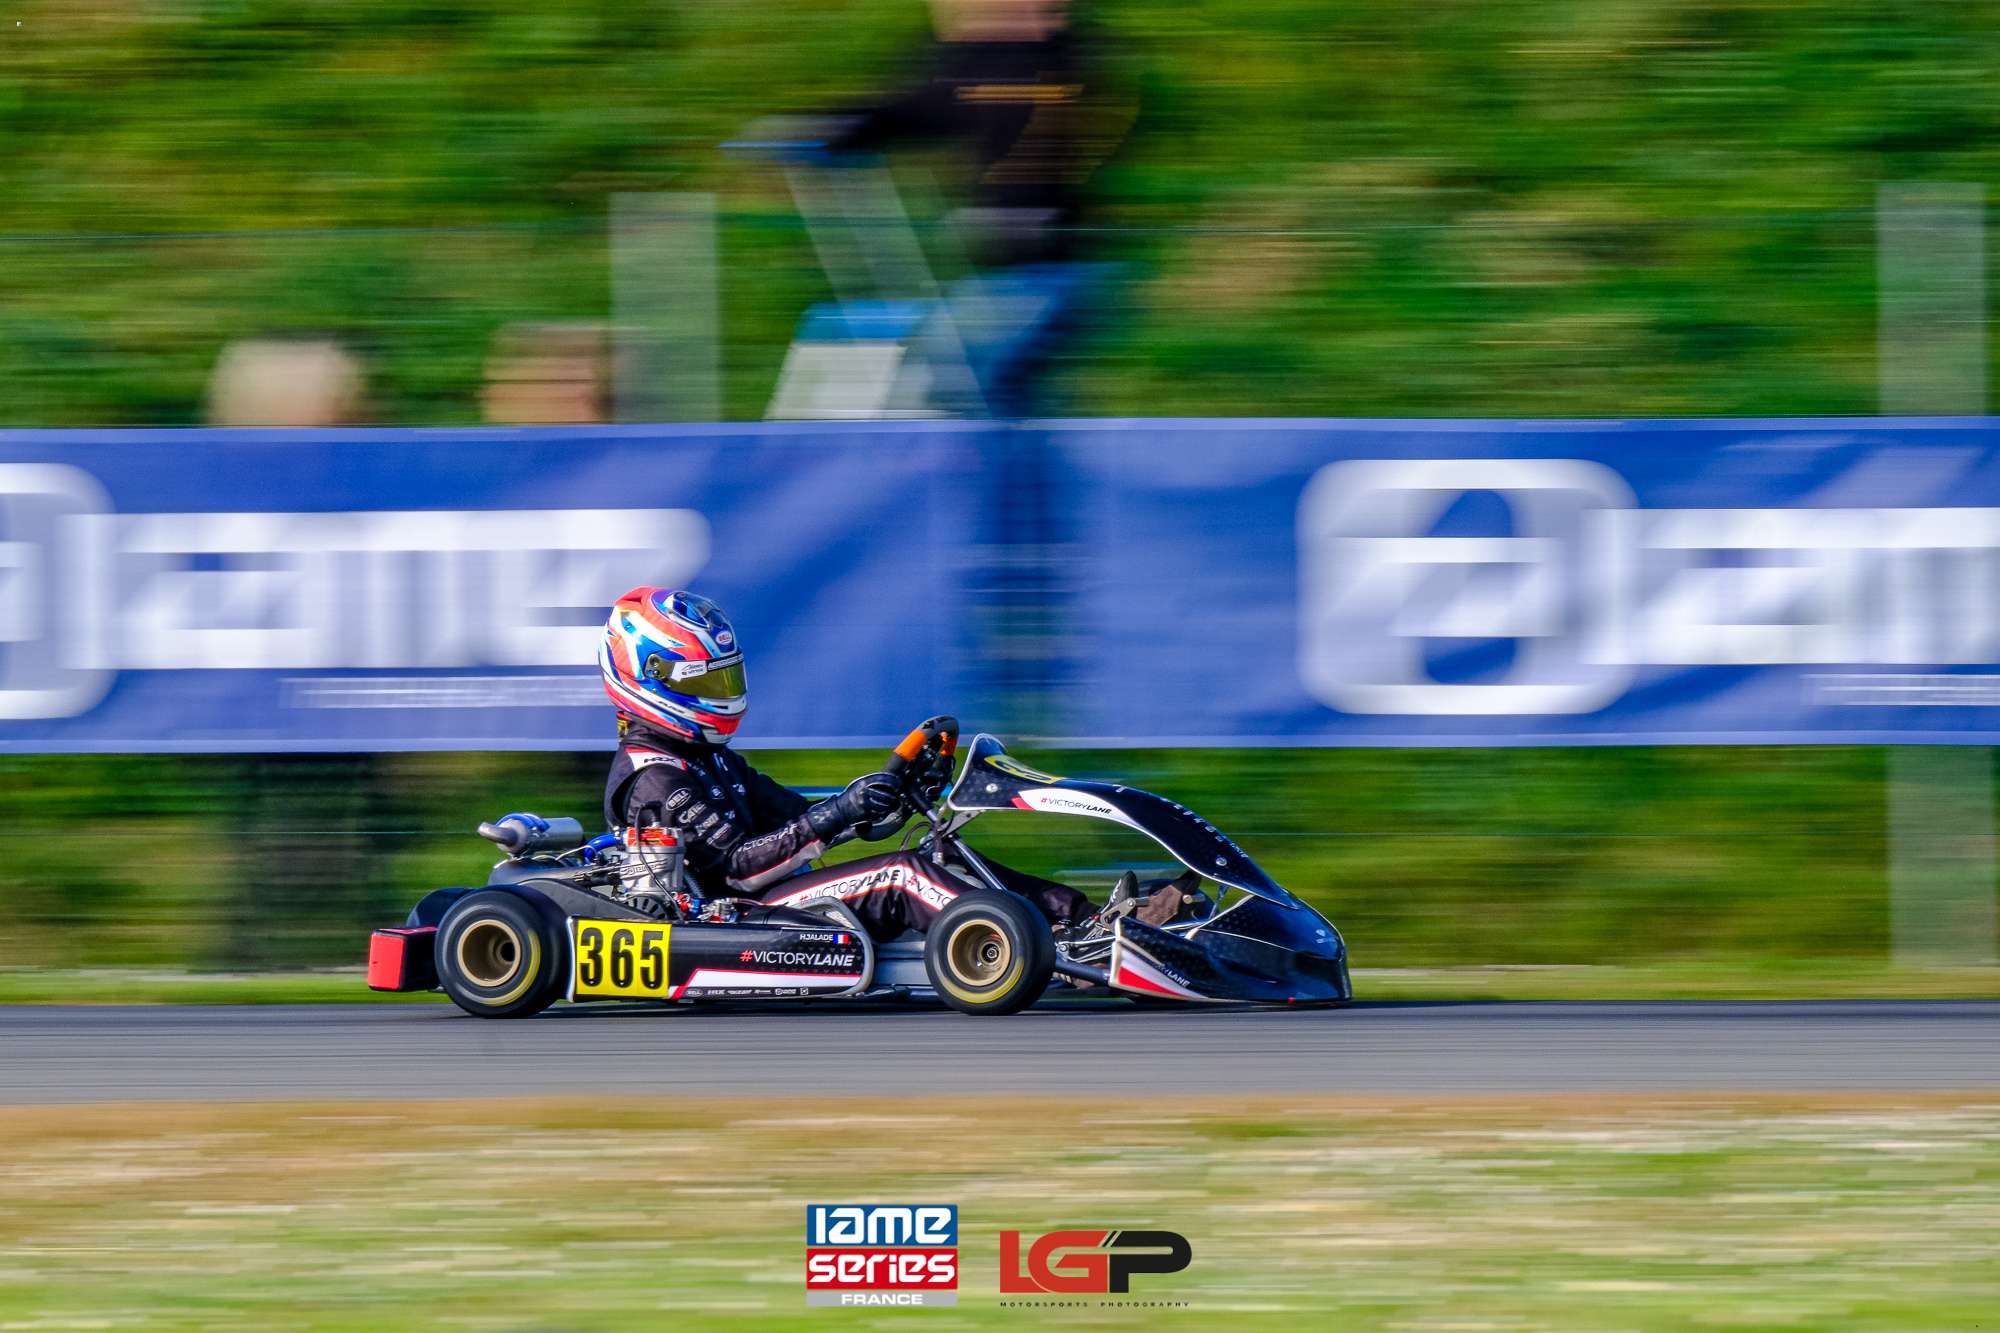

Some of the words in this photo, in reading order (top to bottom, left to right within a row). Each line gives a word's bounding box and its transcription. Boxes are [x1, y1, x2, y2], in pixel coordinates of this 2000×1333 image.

[1041, 797, 1112, 815] #VICTORYLANE
[580, 927, 664, 990] 365
[740, 949, 855, 966] #VICTORYLANE
